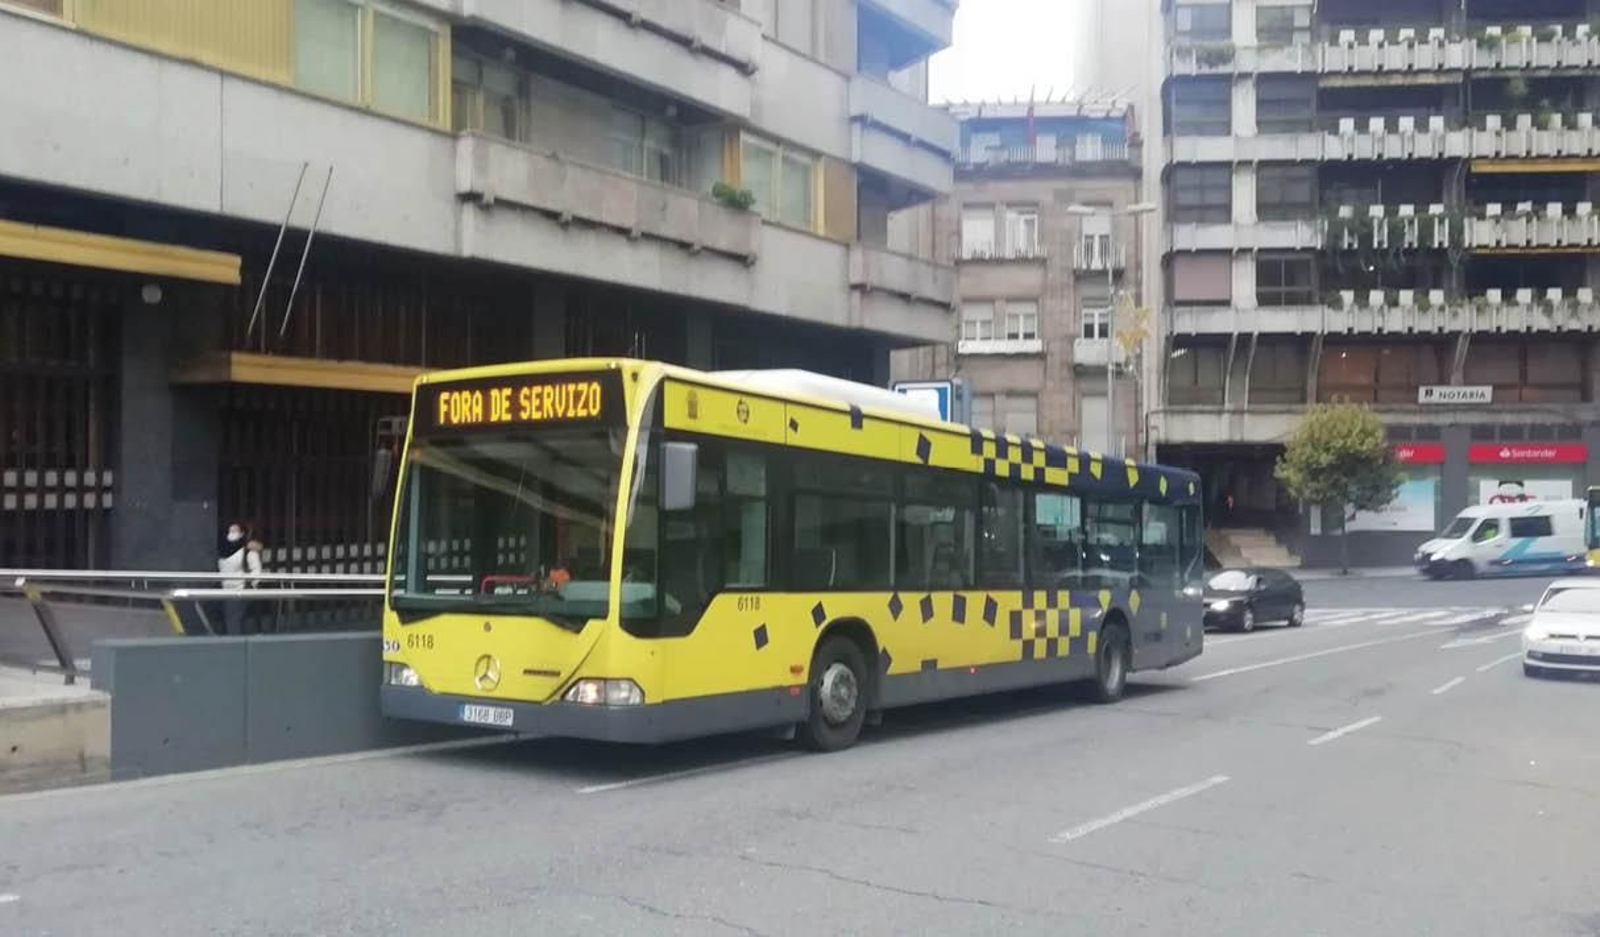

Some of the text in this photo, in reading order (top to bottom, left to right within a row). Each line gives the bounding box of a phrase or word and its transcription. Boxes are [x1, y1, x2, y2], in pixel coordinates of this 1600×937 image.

[439, 381, 601, 424] FORA DE SERVIZO
[1511, 449, 1557, 458] Santander
[737, 595, 760, 612] 6118
[407, 633, 435, 650] 6118
